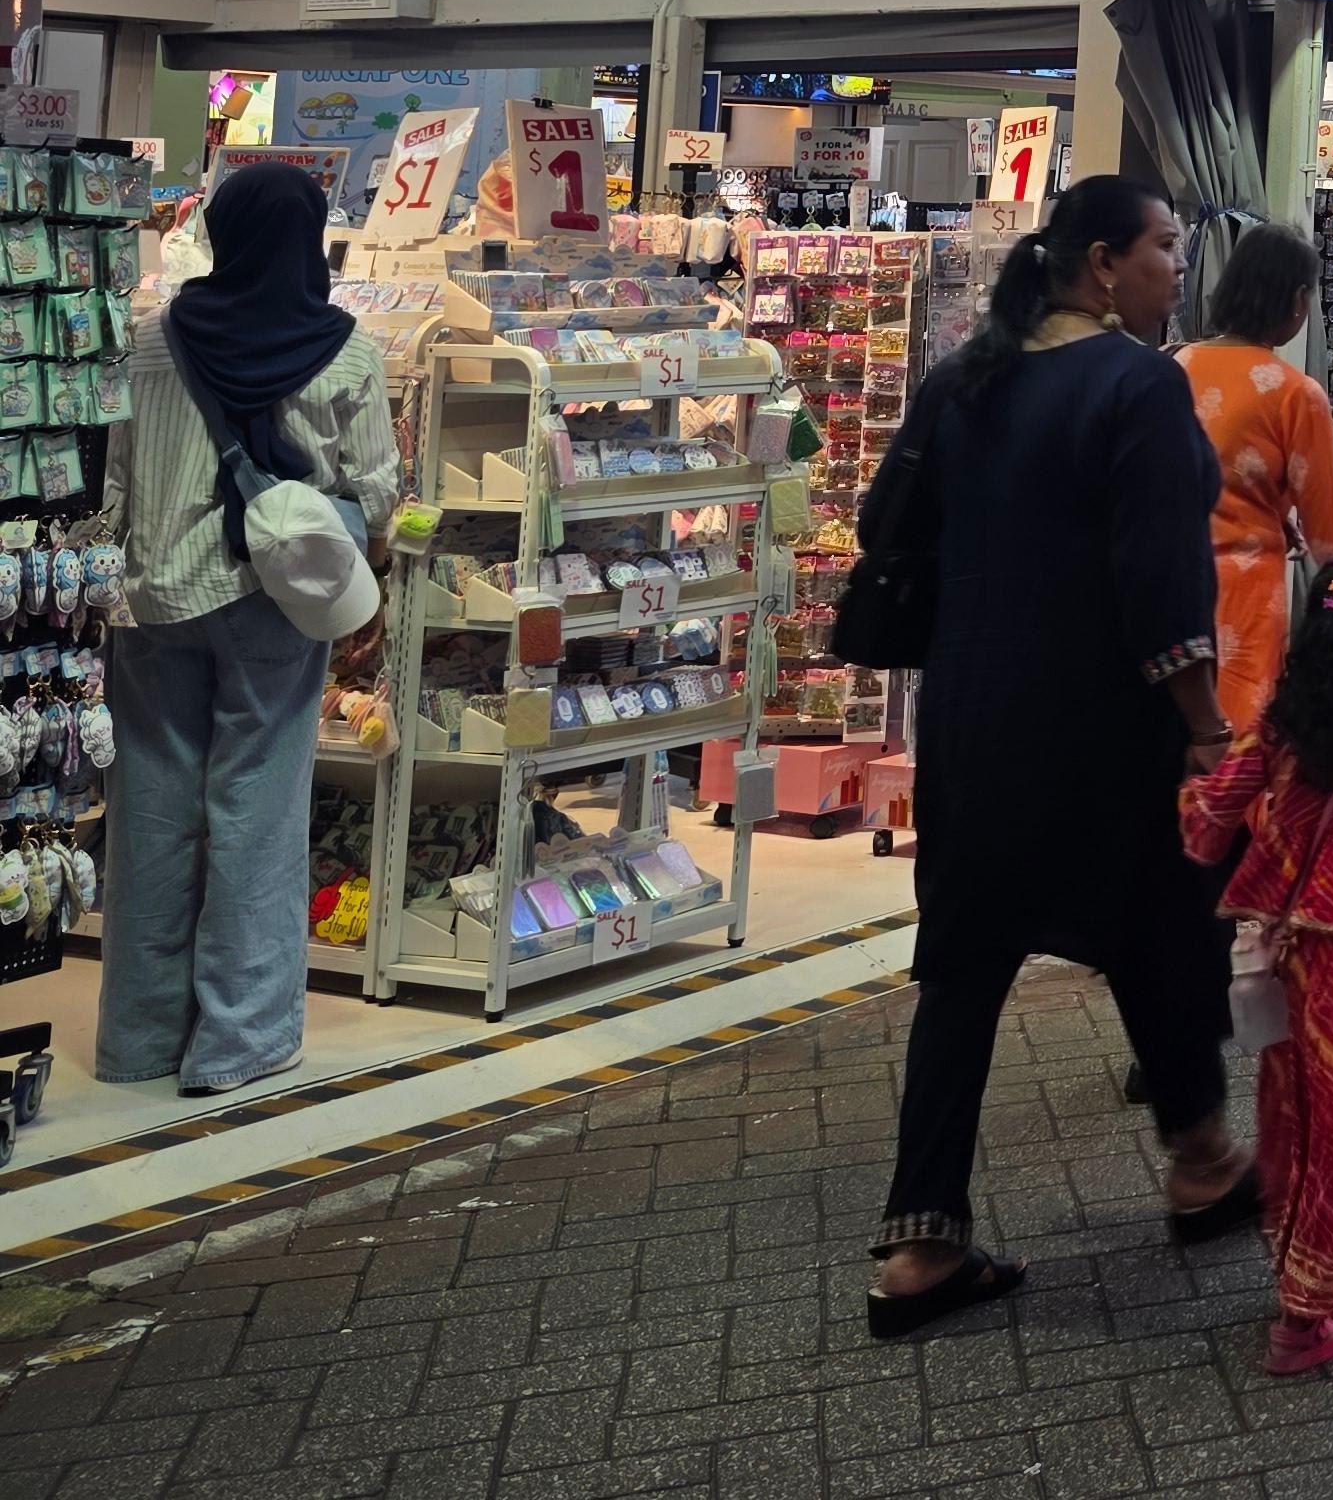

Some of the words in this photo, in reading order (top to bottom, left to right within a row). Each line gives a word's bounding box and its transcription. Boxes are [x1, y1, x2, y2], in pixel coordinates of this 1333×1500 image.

[17, 92, 67, 117] $3.00
[35, 118, 49, 129] for
[524, 118, 593, 142] SALE
[1003, 117, 1047, 144] SALE
[406, 121, 445, 147] SALE
[667, 129, 689, 139] SALE
[684, 135, 711, 161] $2
[822, 141, 841, 149] FOR
[1318, 147, 1328, 158] 5
[226, 153, 273, 166] LUCKY
[278, 153, 317, 166] DRAW
[800, 150, 809, 161] 3
[813, 150, 841, 161] FOR
[384, 155, 440, 216] $1
[975, 201, 996, 209] SALE
[991, 206, 1020, 234] $1
[643, 348, 664, 359] SALE
[658, 353, 685, 388] $1
[626, 579, 648, 590] SALE
[640, 584, 665, 617] $1
[597, 911, 620, 923] SALE
[612, 914, 638, 949] $1
